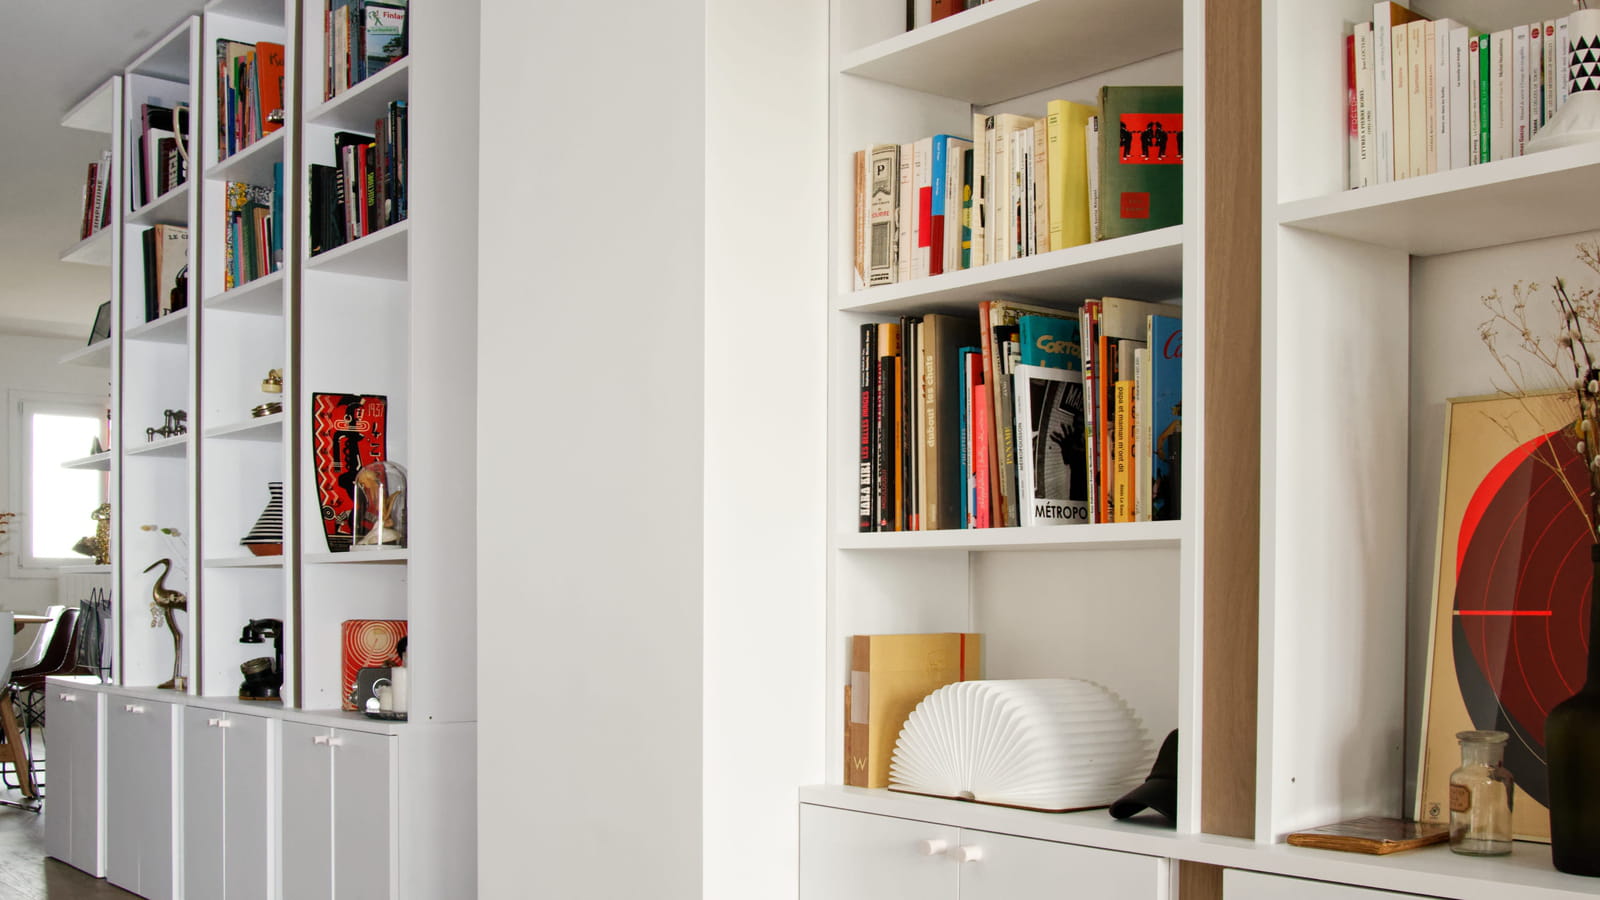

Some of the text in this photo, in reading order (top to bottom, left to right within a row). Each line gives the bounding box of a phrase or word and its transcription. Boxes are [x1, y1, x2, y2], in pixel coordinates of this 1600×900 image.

[925, 355, 934, 385] chats
[368, 403, 385, 417] 1937
[1118, 405, 1124, 413] et
[927, 408, 935, 447] dubout
[1004, 426, 1013, 465] PANAME
[860, 461, 871, 516] HARA KIRI
[1035, 501, 1088, 520] MÉTROPO
[854, 756, 867, 771] W
